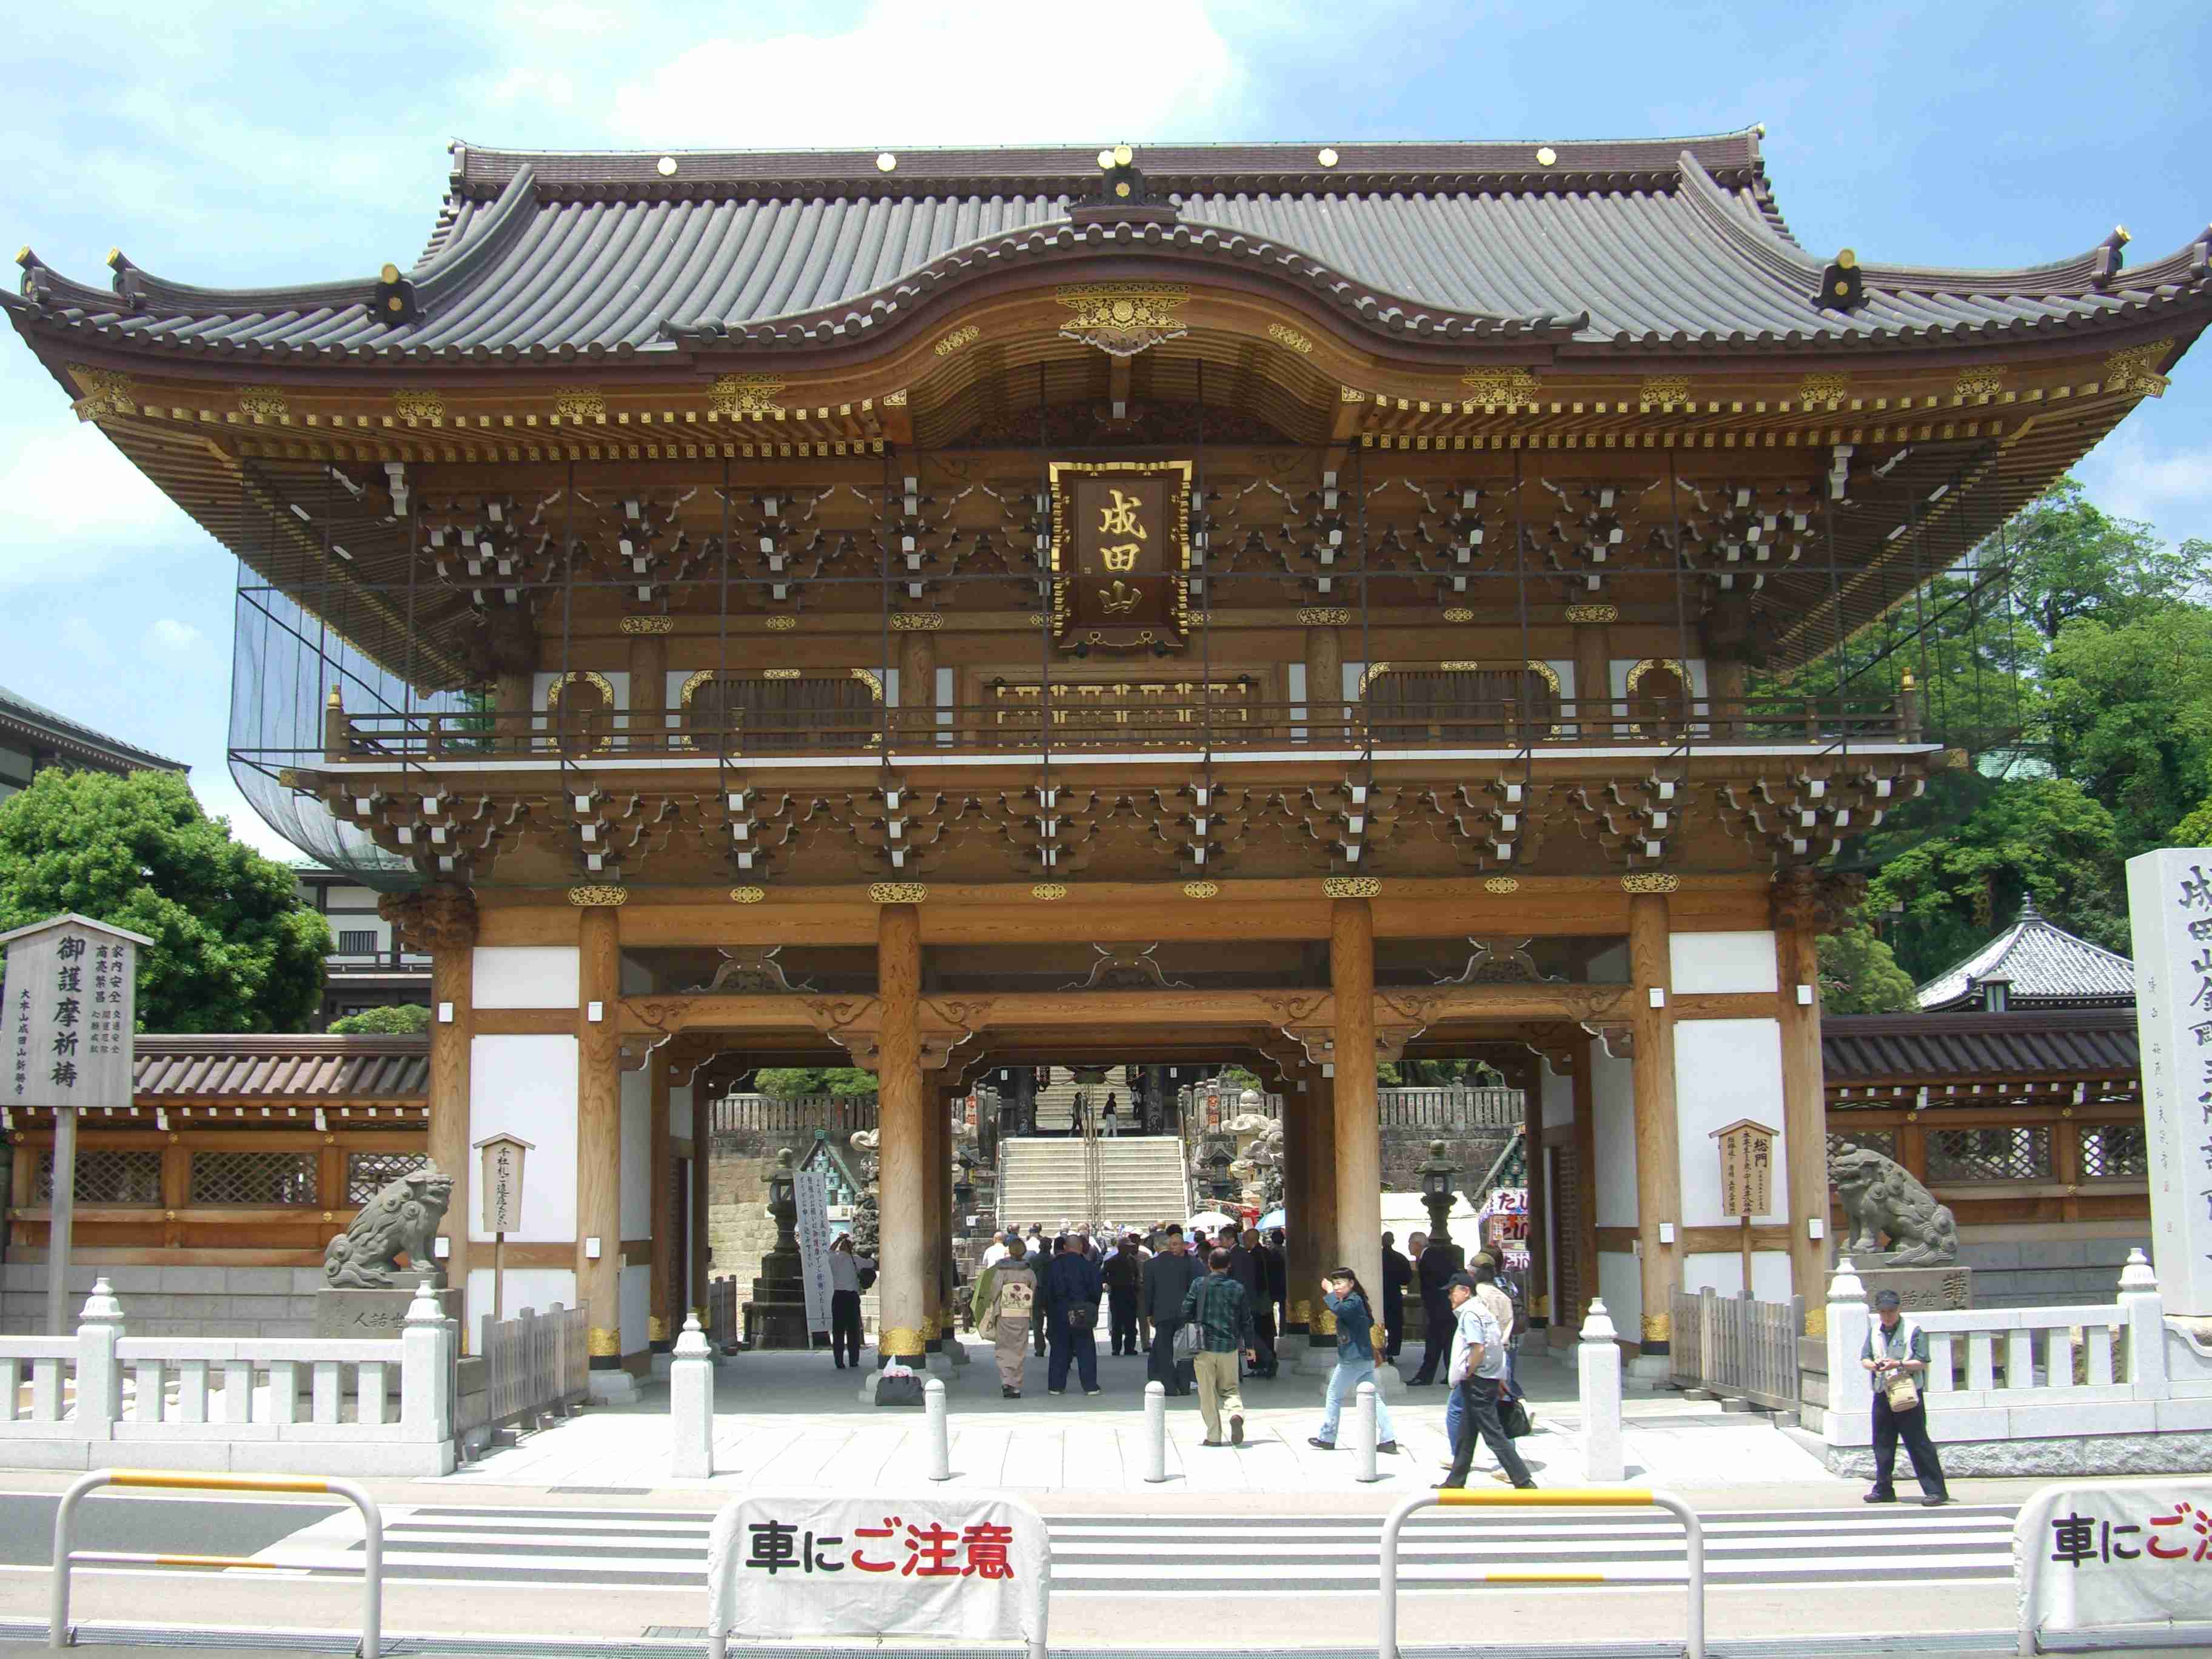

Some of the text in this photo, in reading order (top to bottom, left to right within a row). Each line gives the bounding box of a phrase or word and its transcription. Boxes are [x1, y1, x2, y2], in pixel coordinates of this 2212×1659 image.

[1098, 489, 1148, 614] 成田山
[109, 945, 124, 1003] 家内安全
[745, 1516, 1014, 1580] 車にご注意
